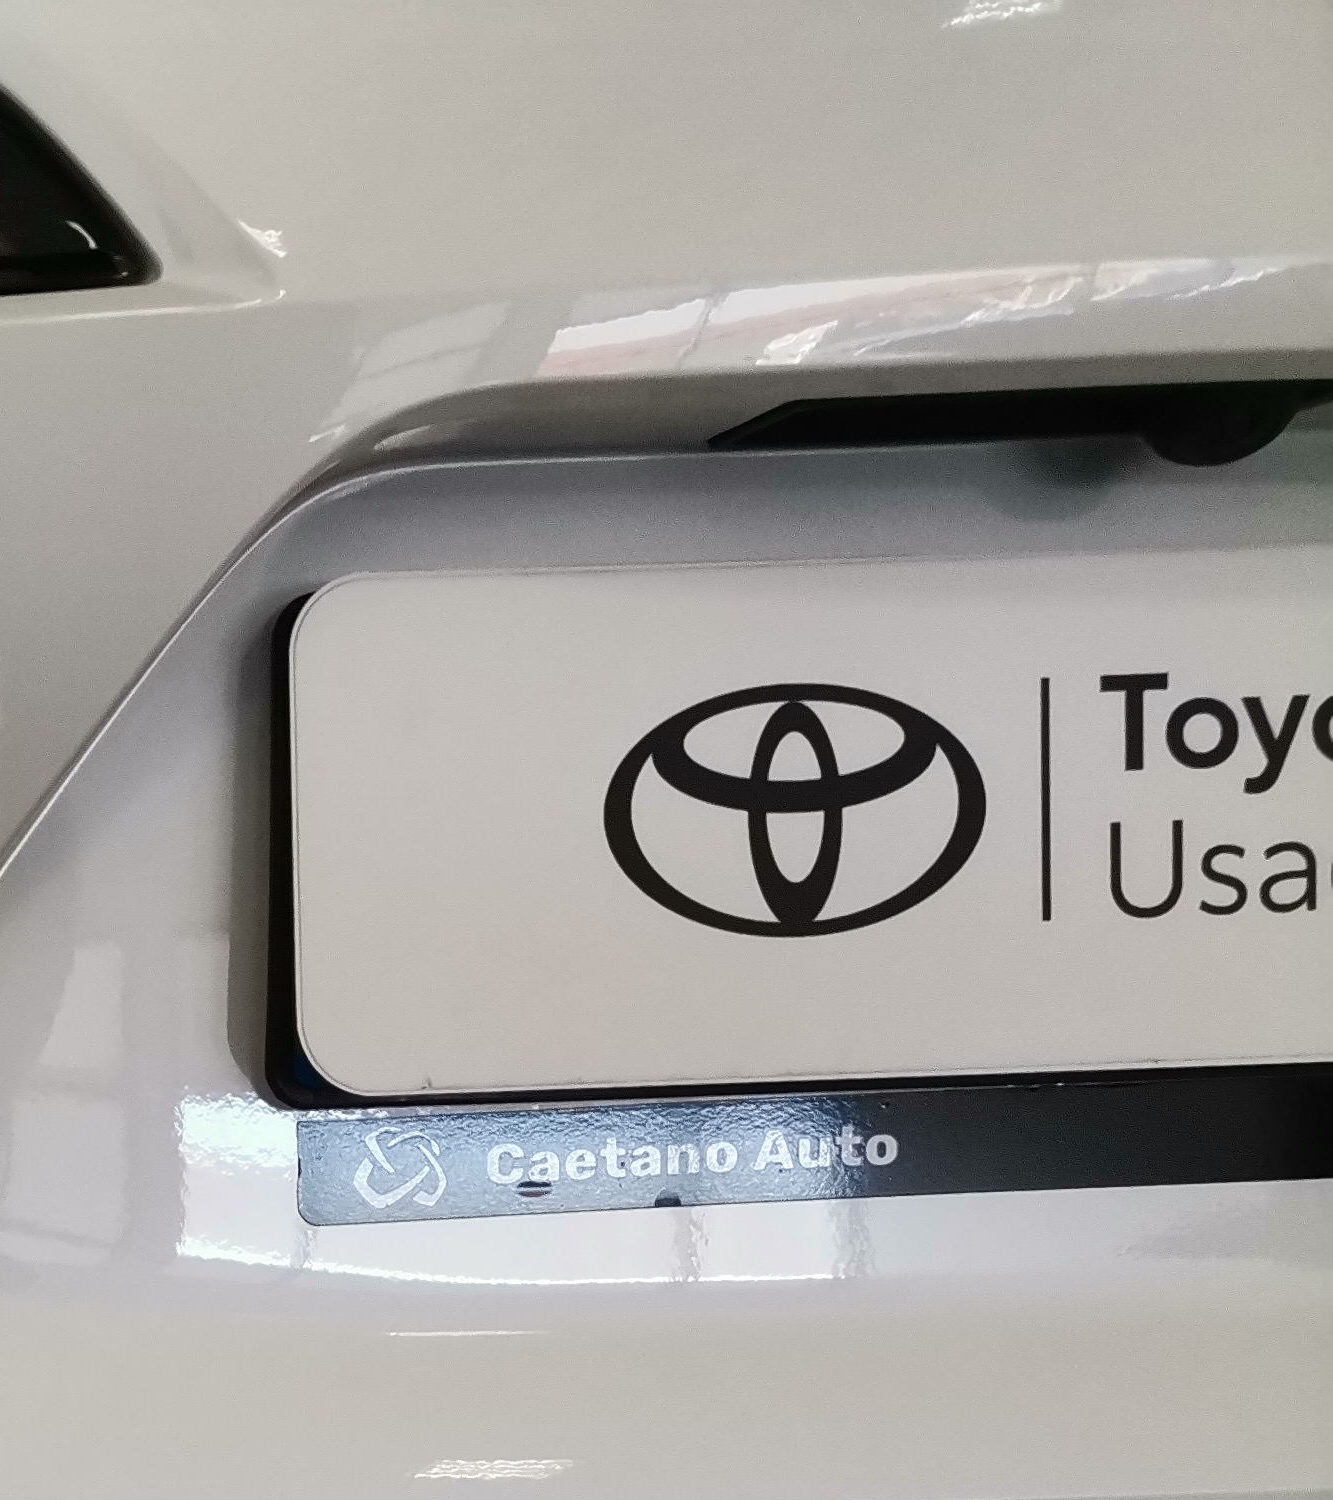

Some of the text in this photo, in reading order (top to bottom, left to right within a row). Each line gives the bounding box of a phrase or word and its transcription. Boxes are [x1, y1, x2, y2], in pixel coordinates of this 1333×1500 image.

[1110, 819, 1333, 919] Usa
[486, 1124, 899, 1185] Caetano Auto
